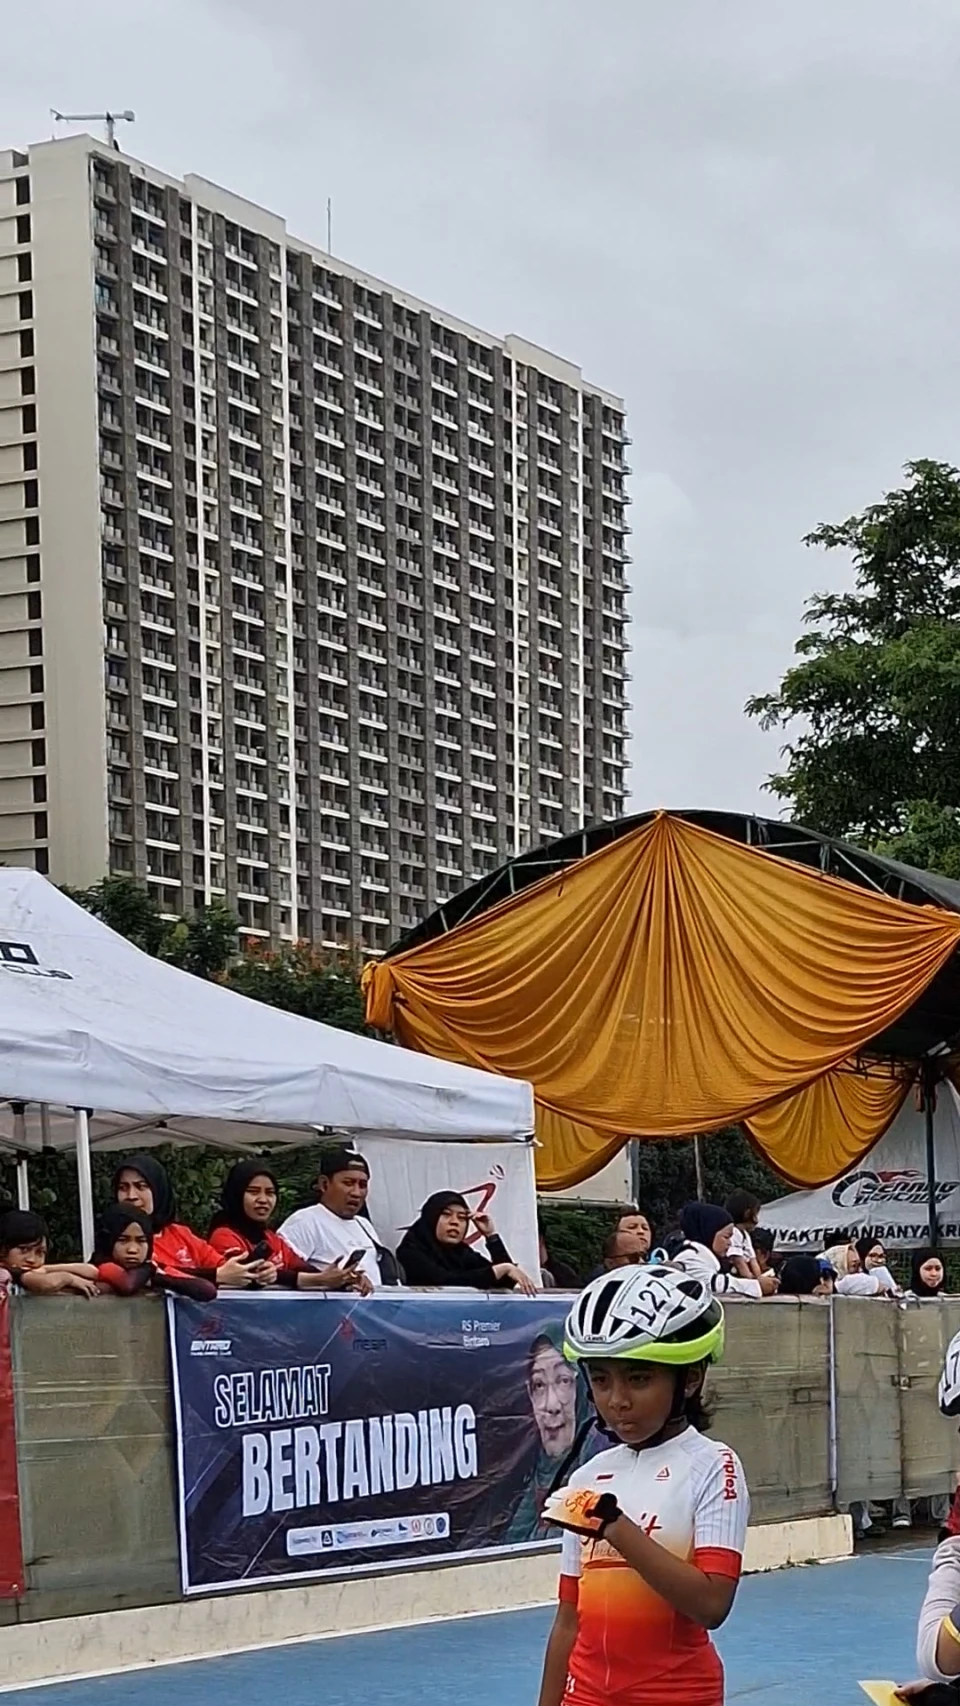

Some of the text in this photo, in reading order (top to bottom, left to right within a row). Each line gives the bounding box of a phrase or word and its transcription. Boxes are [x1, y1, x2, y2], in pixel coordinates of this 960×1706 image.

[631, 1279, 673, 1328] 127
[214, 1364, 331, 1428] SELAMAT
[242, 1403, 478, 1517] BERTANDING
